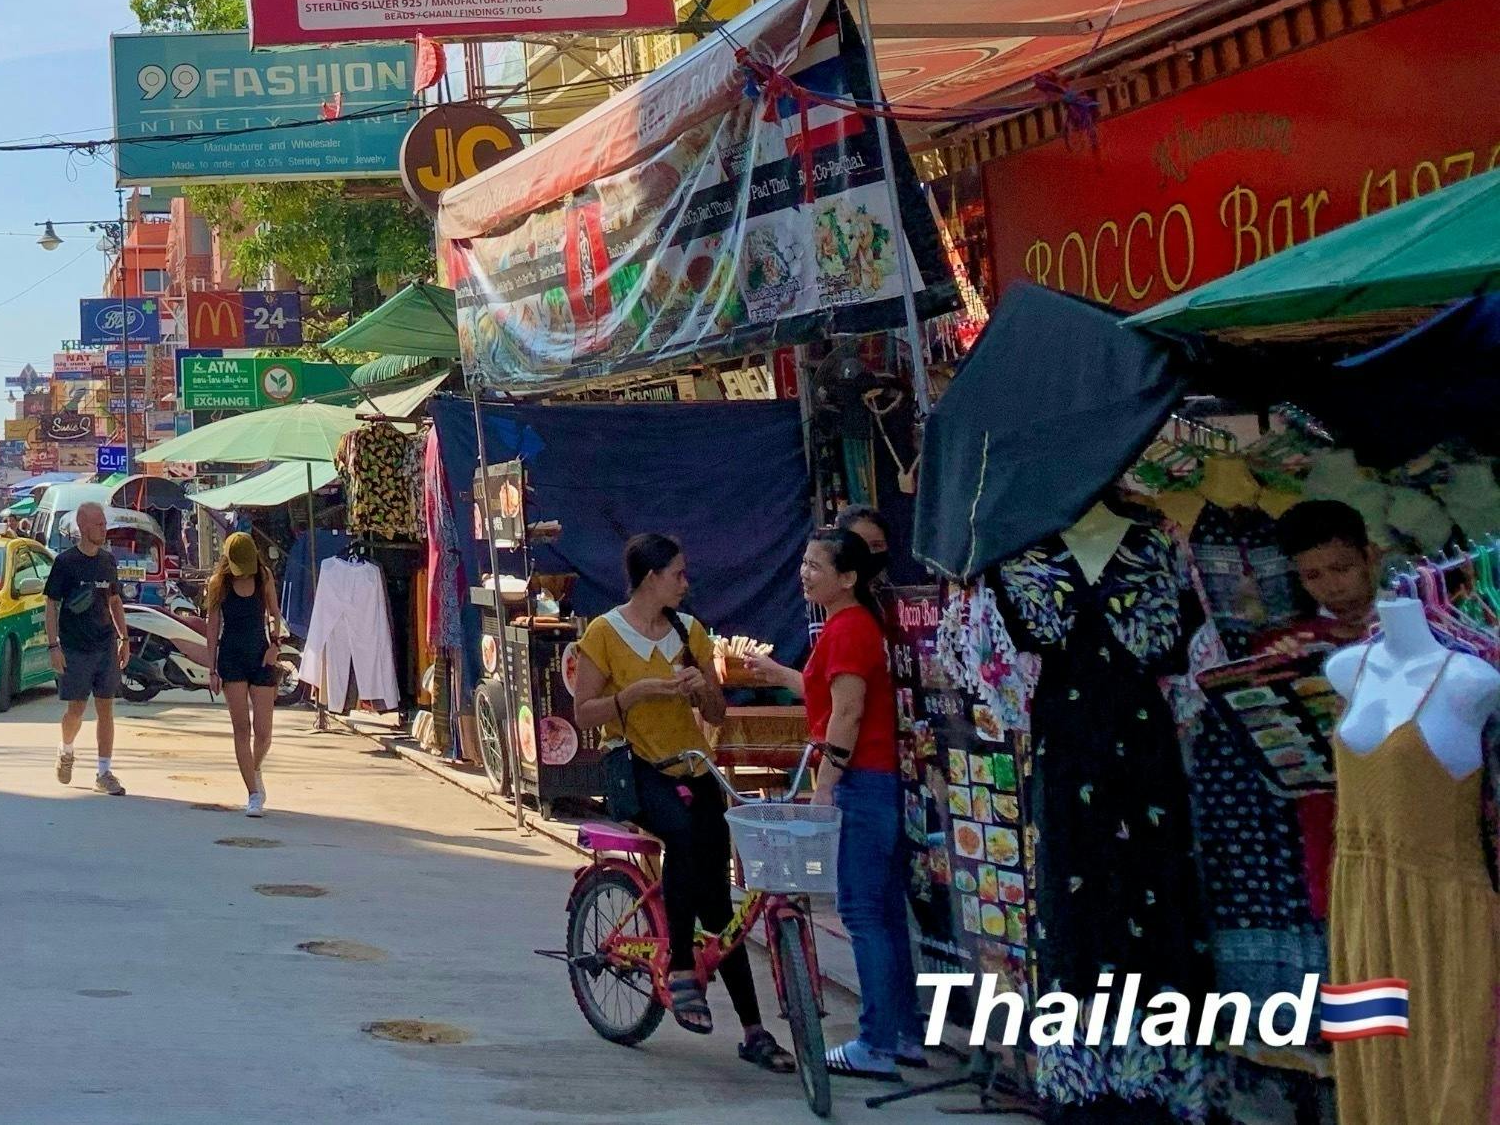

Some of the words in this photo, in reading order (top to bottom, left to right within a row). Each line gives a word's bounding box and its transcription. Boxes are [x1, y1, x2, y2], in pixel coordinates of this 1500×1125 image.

[305, 0, 360, 13] STERLING
[384, 10, 416, 22] BEADS
[422, 9, 452, 20] CHAIN
[459, 7, 505, 19] FINDINGS
[511, 5, 542, 17] TOOLS
[136, 62, 201, 101] 99
[204, 60, 406, 97] FASHION
[140, 117, 280, 133] NINETY
[203, 139, 263, 153] Manufacturer
[268, 140, 286, 151] and
[290, 137, 341, 150] Wholesaler
[171, 160, 195, 171] Made
[198, 160, 209, 170] to
[213, 159, 236, 170] order
[240, 158, 250, 169] of
[254, 157, 284, 168] 92.5%
[287, 155, 321, 169] Sterling
[325, 154, 349, 166] Silver
[354, 153, 387, 168] Jewelry
[417, 124, 513, 194] JC
[750, 182, 771, 201] Pad
[770, 177, 791, 195] Thai
[1220, 185, 1331, 273] Bar
[254, 307, 287, 329] 24
[208, 361, 239, 374] ATM
[193, 397, 251, 406] EXCHANGE
